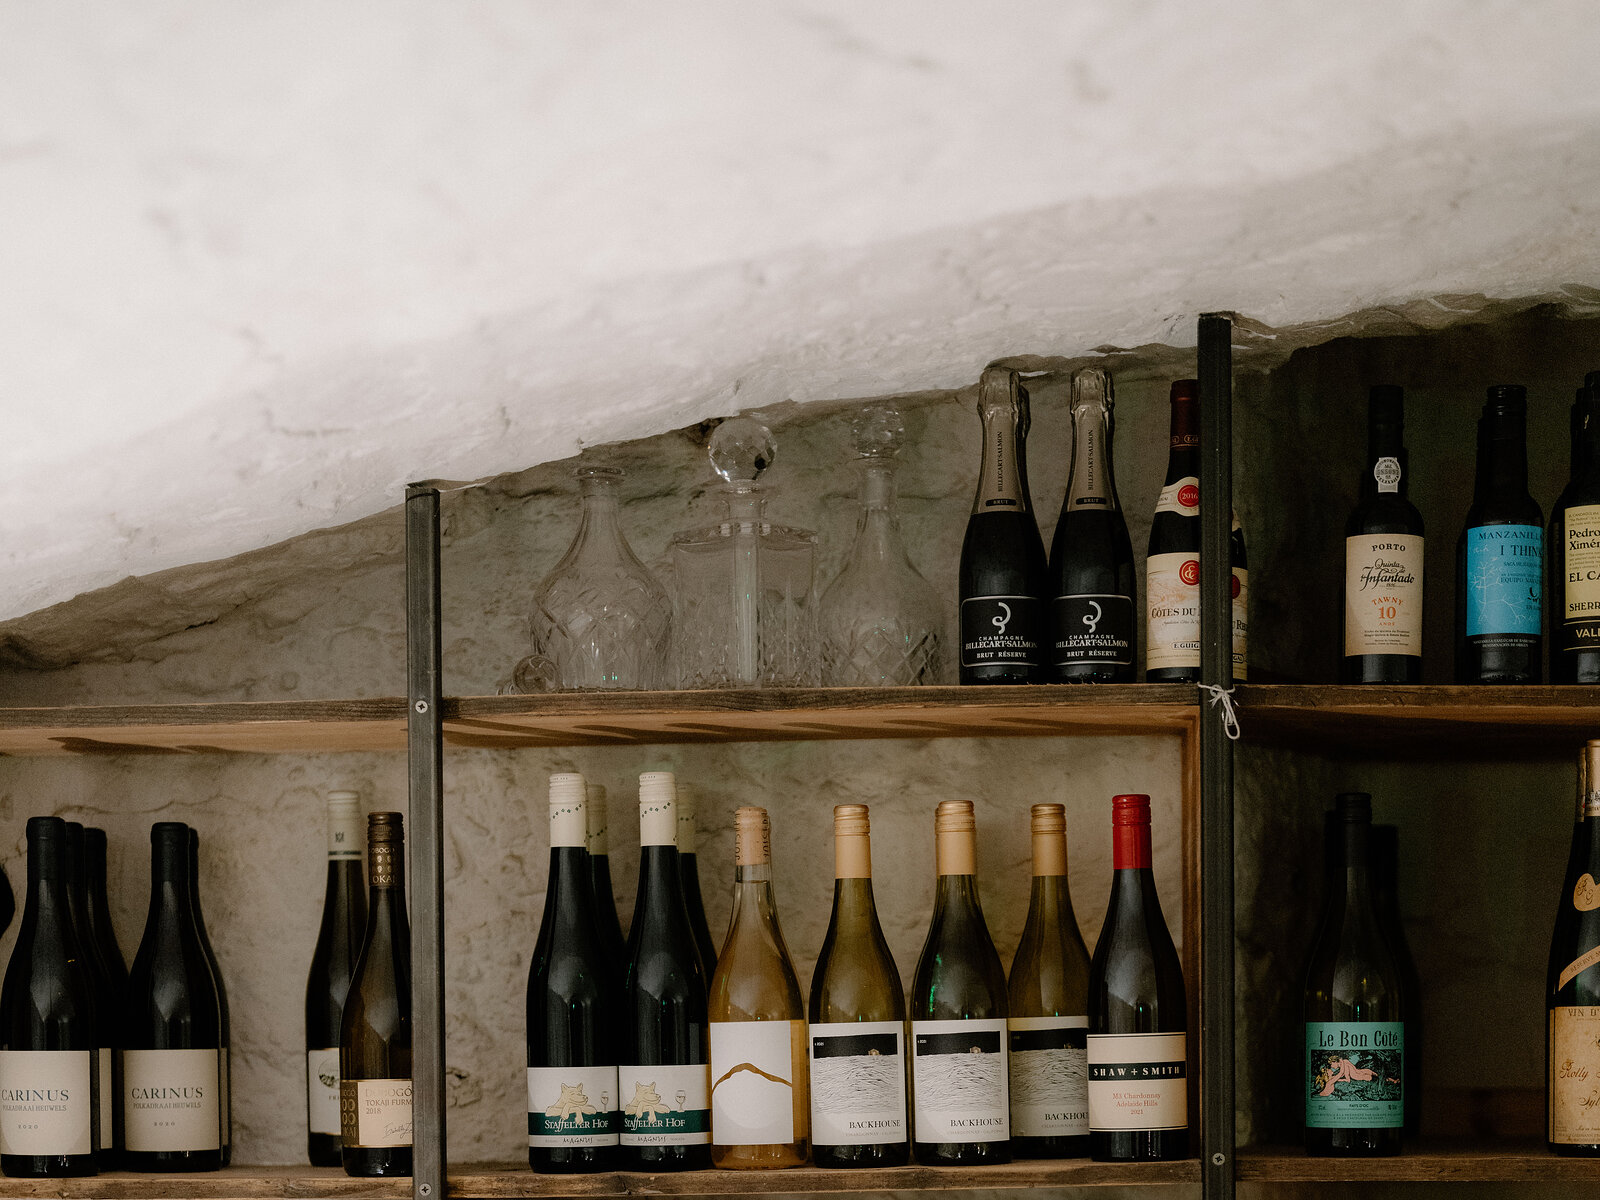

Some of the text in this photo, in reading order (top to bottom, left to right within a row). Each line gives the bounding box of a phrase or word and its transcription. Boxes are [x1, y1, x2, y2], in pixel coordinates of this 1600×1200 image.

[1371, 543, 1406, 552] PORTO
[1500, 545, 1505, 556] I
[1374, 558, 1400, 568] Quinta
[1360, 567, 1415, 591] Infantado
[1569, 573, 1583, 583] EL
[1371, 596, 1404, 606] TAWNY
[1569, 602, 1600, 612] SHERR
[1151, 607, 1196, 618] CÔTES DU
[1378, 606, 1396, 619] 10
[965, 640, 1038, 650] BILLECART-SALMON
[1056, 639, 1128, 648] BILLECART-SALMON
[976, 650, 1027, 659] BRUT RÉSERVE
[1067, 649, 1117, 658] BRUT RÉSERVE
[1568, 1008, 1585, 1017] VIN
[1319, 1030, 1398, 1047] Le Bon Côté
[1093, 1067, 1127, 1077] SHAW
[1142, 1066, 1180, 1076] SMITH
[1, 1089, 69, 1102] CARINUS
[131, 1087, 203, 1099] CARINUS
[1123, 1092, 1161, 1100] Chardonnay
[365, 1099, 390, 1107] TOKAJI
[1578, 1090, 1600, 1109] Syl
[1045, 1112, 1088, 1121] BACKHOU
[849, 1119, 901, 1129] BACKHOUSE
[950, 1117, 1004, 1127] BACKHOUSE
